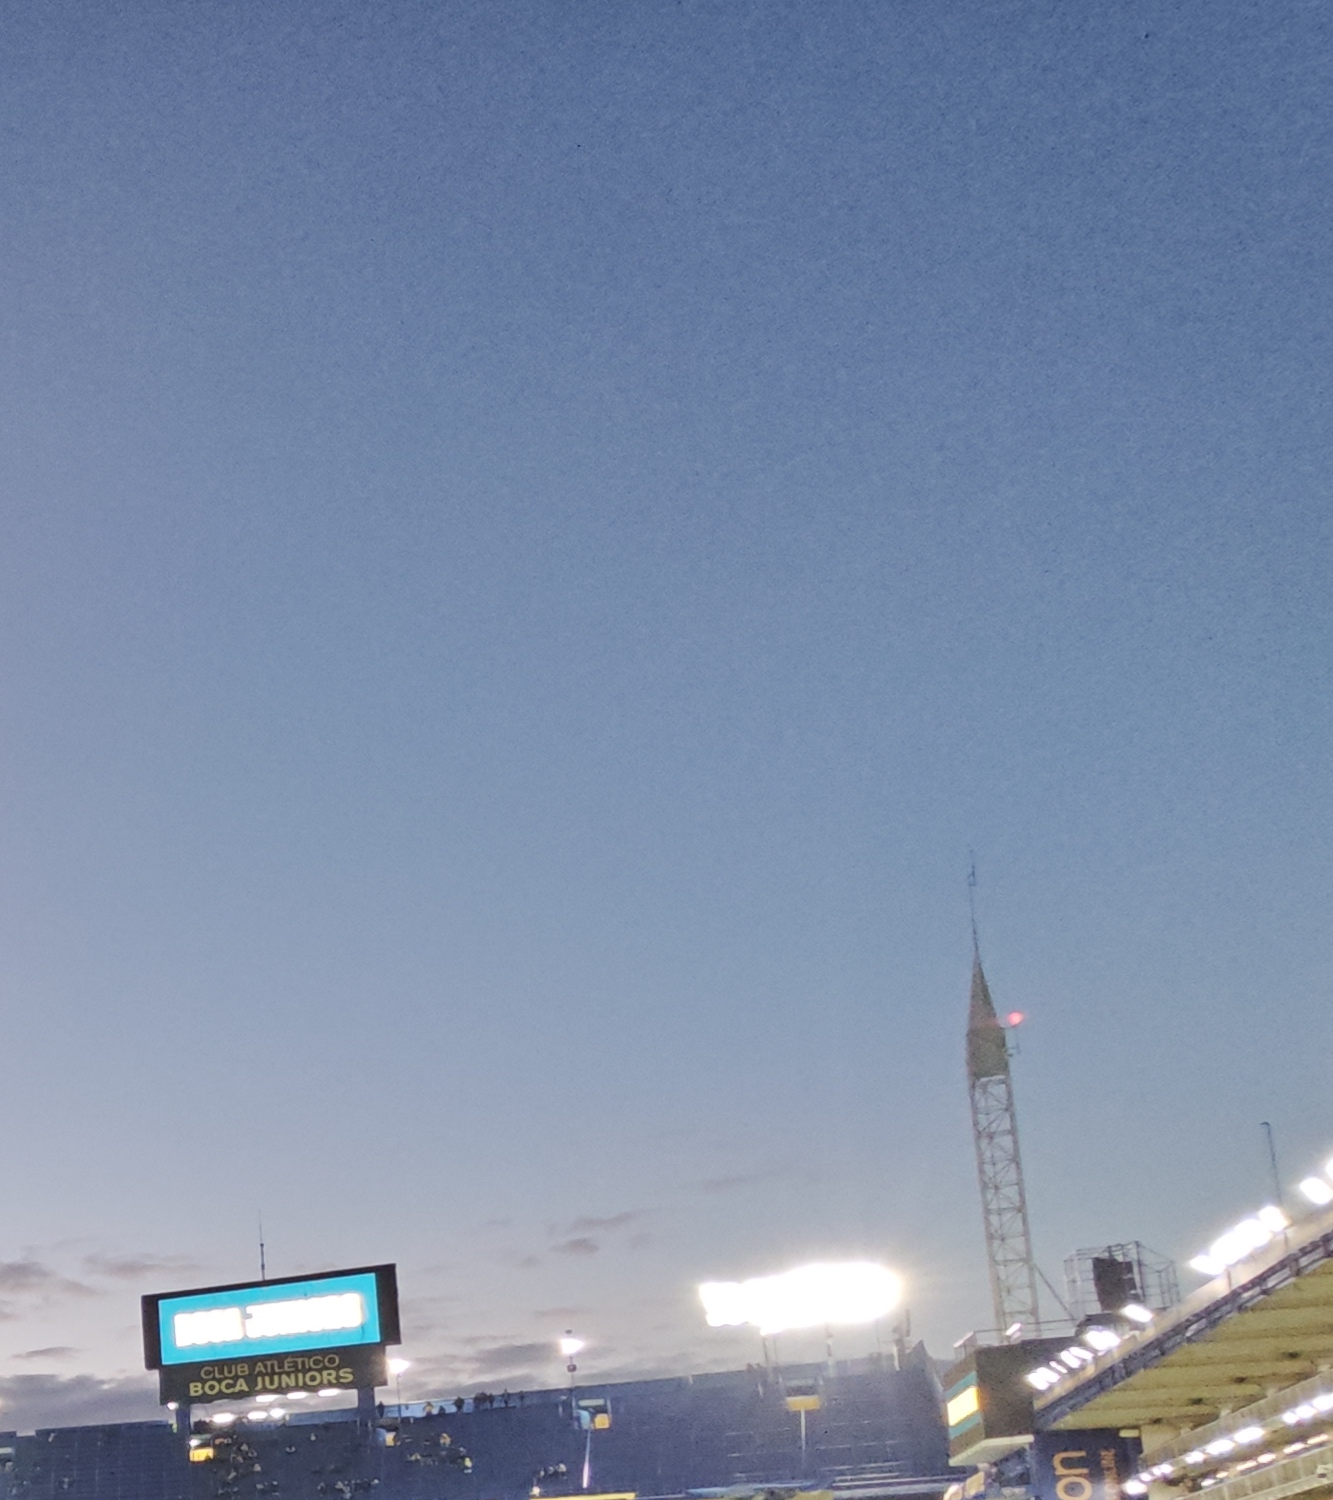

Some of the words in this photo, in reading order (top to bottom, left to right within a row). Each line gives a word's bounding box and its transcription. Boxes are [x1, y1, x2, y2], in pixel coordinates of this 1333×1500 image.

[200, 1362, 250, 1380] CLUB
[253, 1354, 340, 1375] ATLÉTICO
[188, 1378, 250, 1397] BOCA
[254, 1367, 354, 1391] JUNIORS
